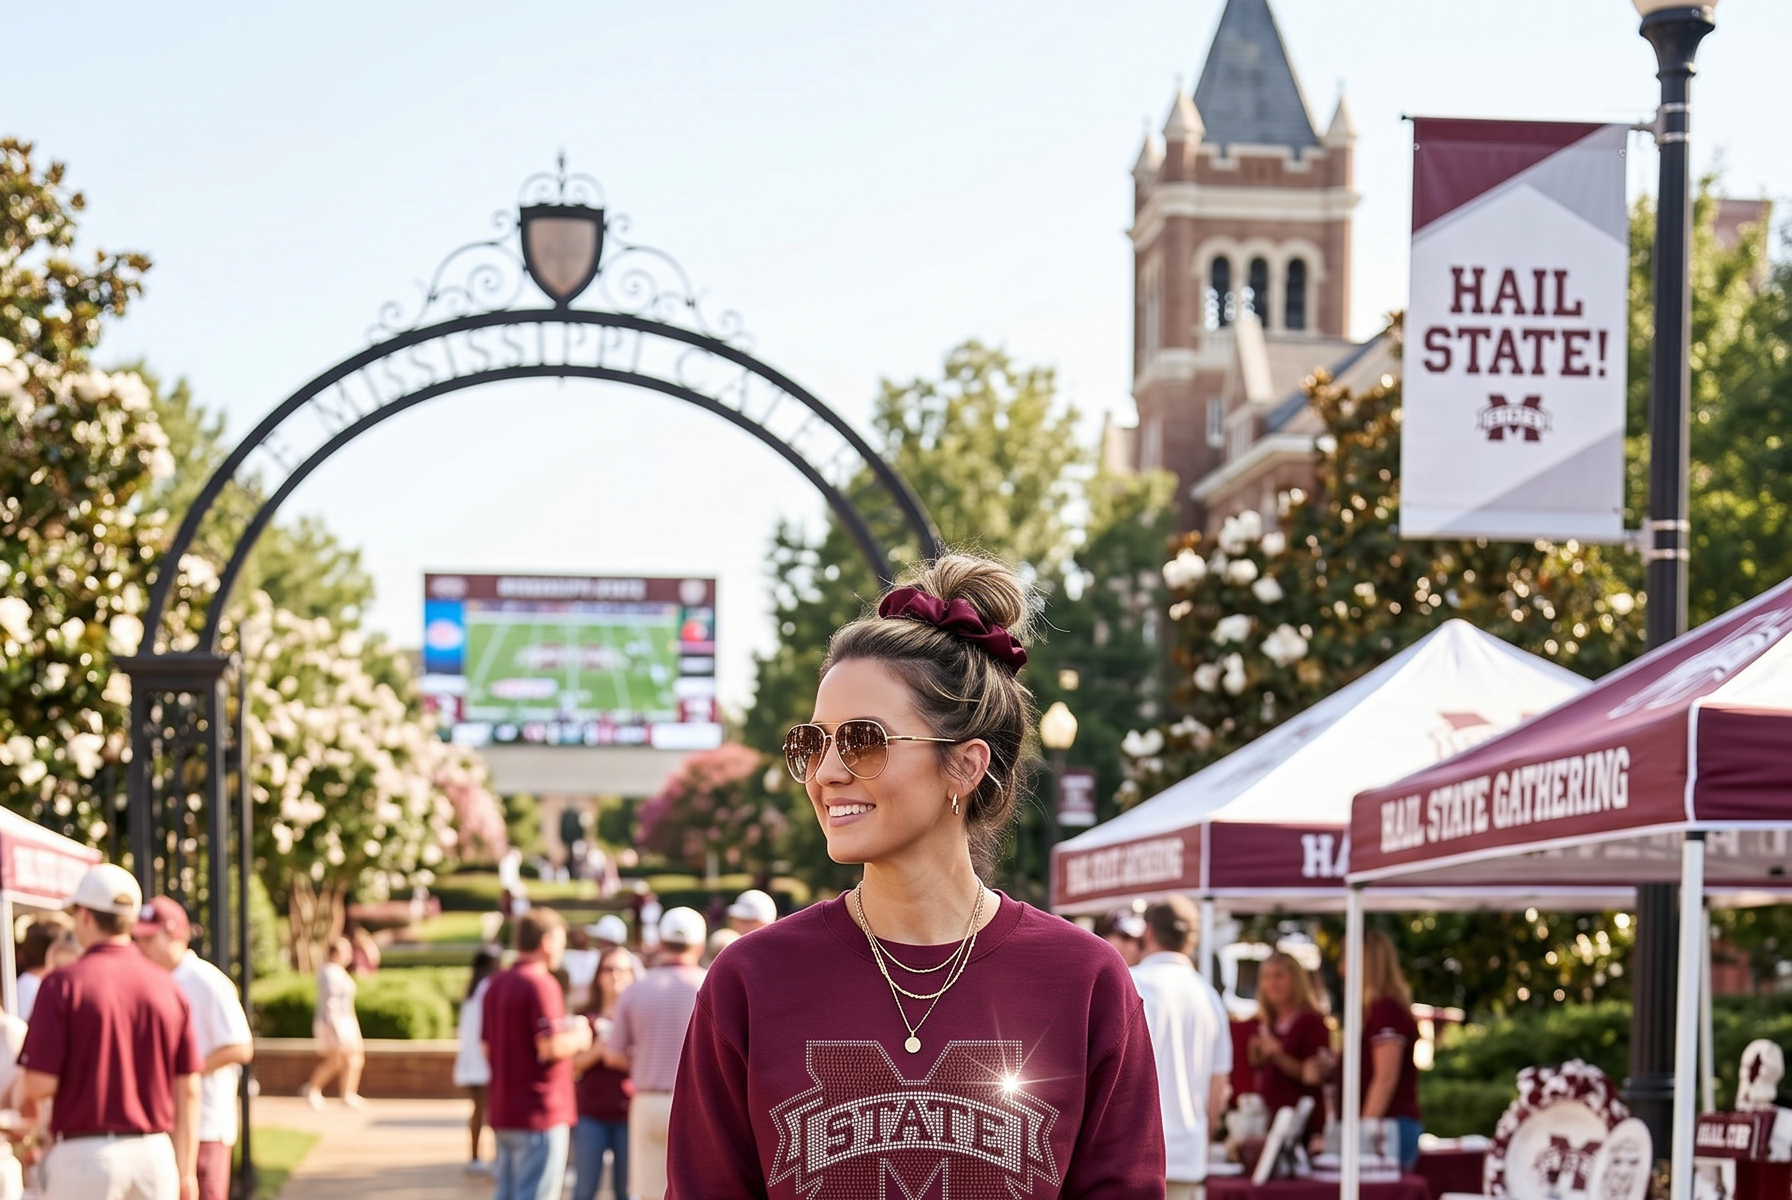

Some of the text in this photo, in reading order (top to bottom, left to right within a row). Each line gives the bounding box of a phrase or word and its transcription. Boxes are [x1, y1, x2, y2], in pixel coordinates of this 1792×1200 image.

[1451, 267, 1583, 316] HAIL
[309, 320, 642, 440] MISSISSIPPI
[1423, 326, 1607, 377] STATE!
[1380, 746, 1630, 853] HAIL STATE GATHERING
[822, 1099, 1008, 1158] STATE
